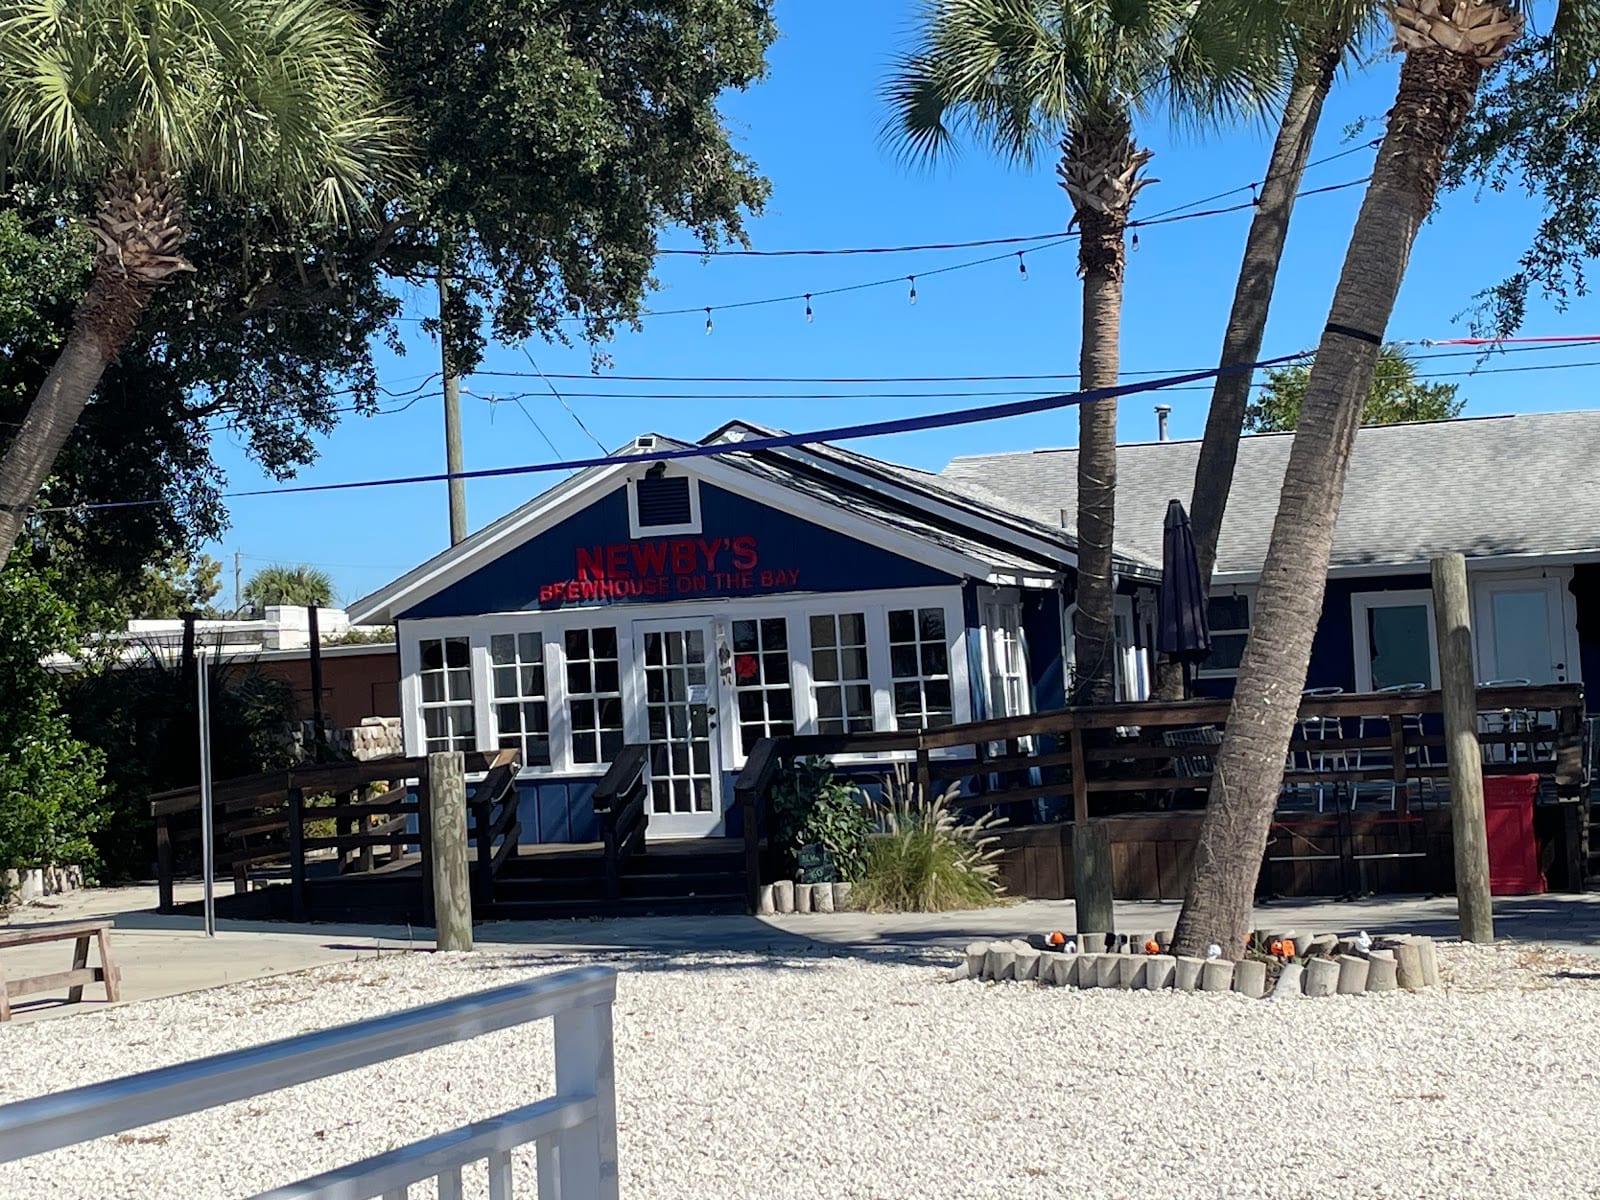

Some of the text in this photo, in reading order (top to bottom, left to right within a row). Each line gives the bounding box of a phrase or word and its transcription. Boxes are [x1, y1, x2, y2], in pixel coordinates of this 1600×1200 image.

[575, 535, 759, 580] NEWBY'S
[538, 567, 800, 603] BREWHOUSE ON THE BAY
